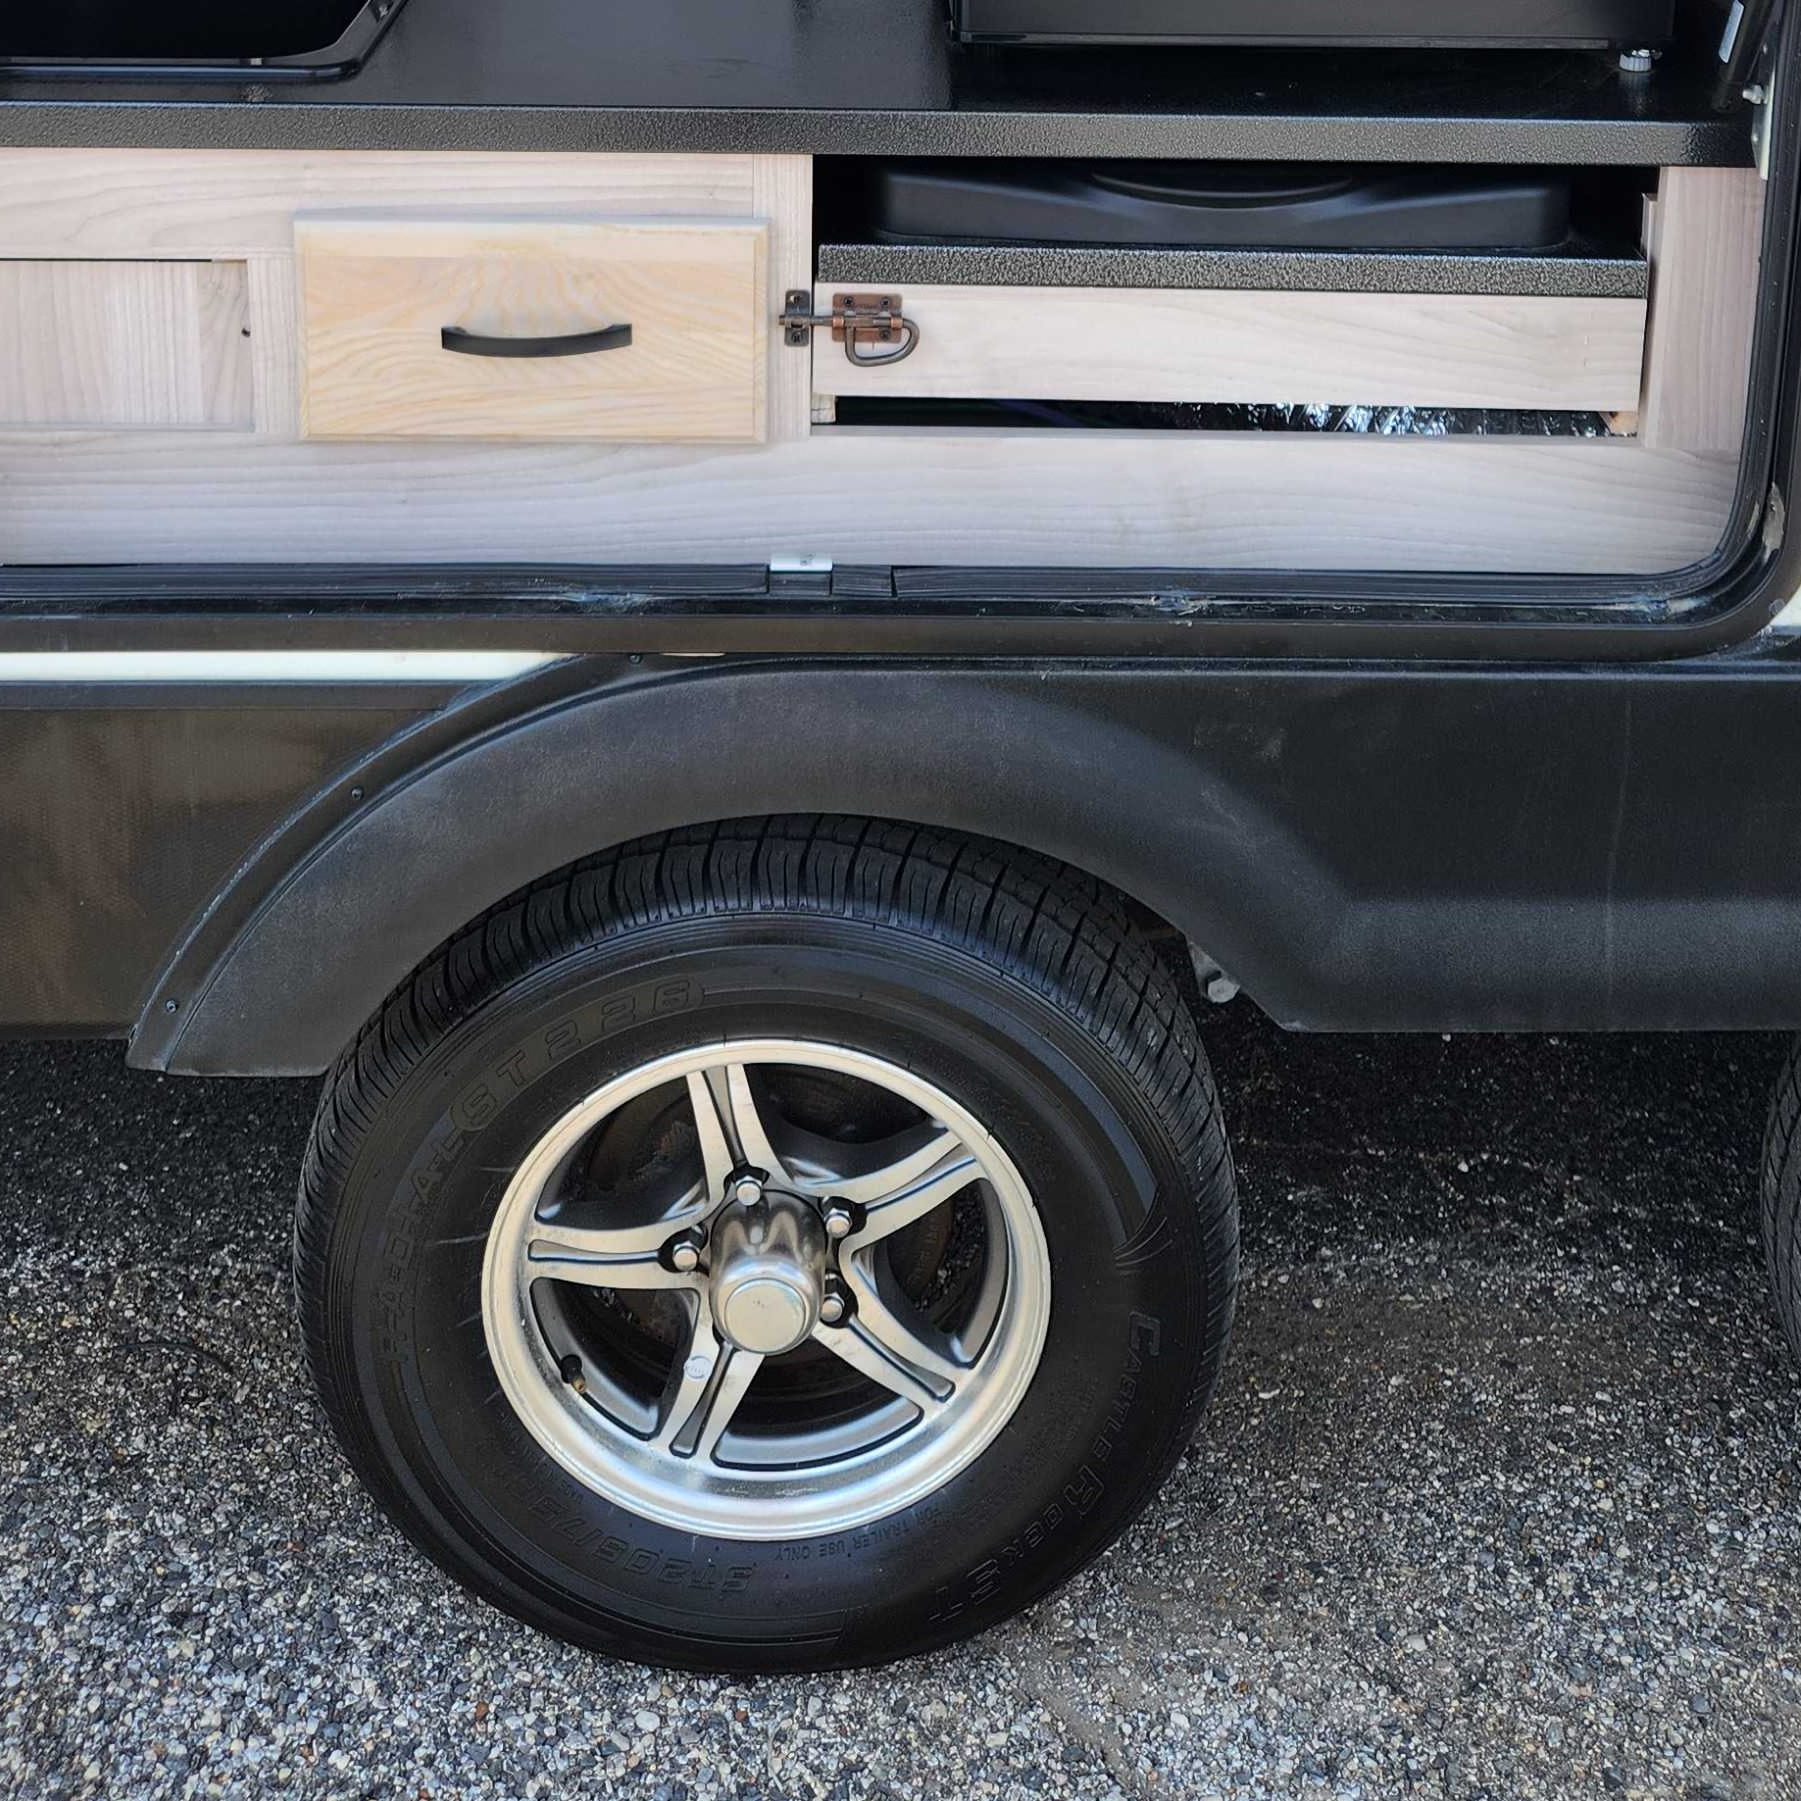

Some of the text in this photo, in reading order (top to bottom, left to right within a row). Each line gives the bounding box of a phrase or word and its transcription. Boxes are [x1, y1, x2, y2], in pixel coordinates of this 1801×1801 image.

[1092, 1308, 1162, 1461] CASTLE
[851, 1518, 911, 1550] TRAILER
[771, 1543, 812, 1561] ONLY
[818, 1540, 846, 1556] USE
